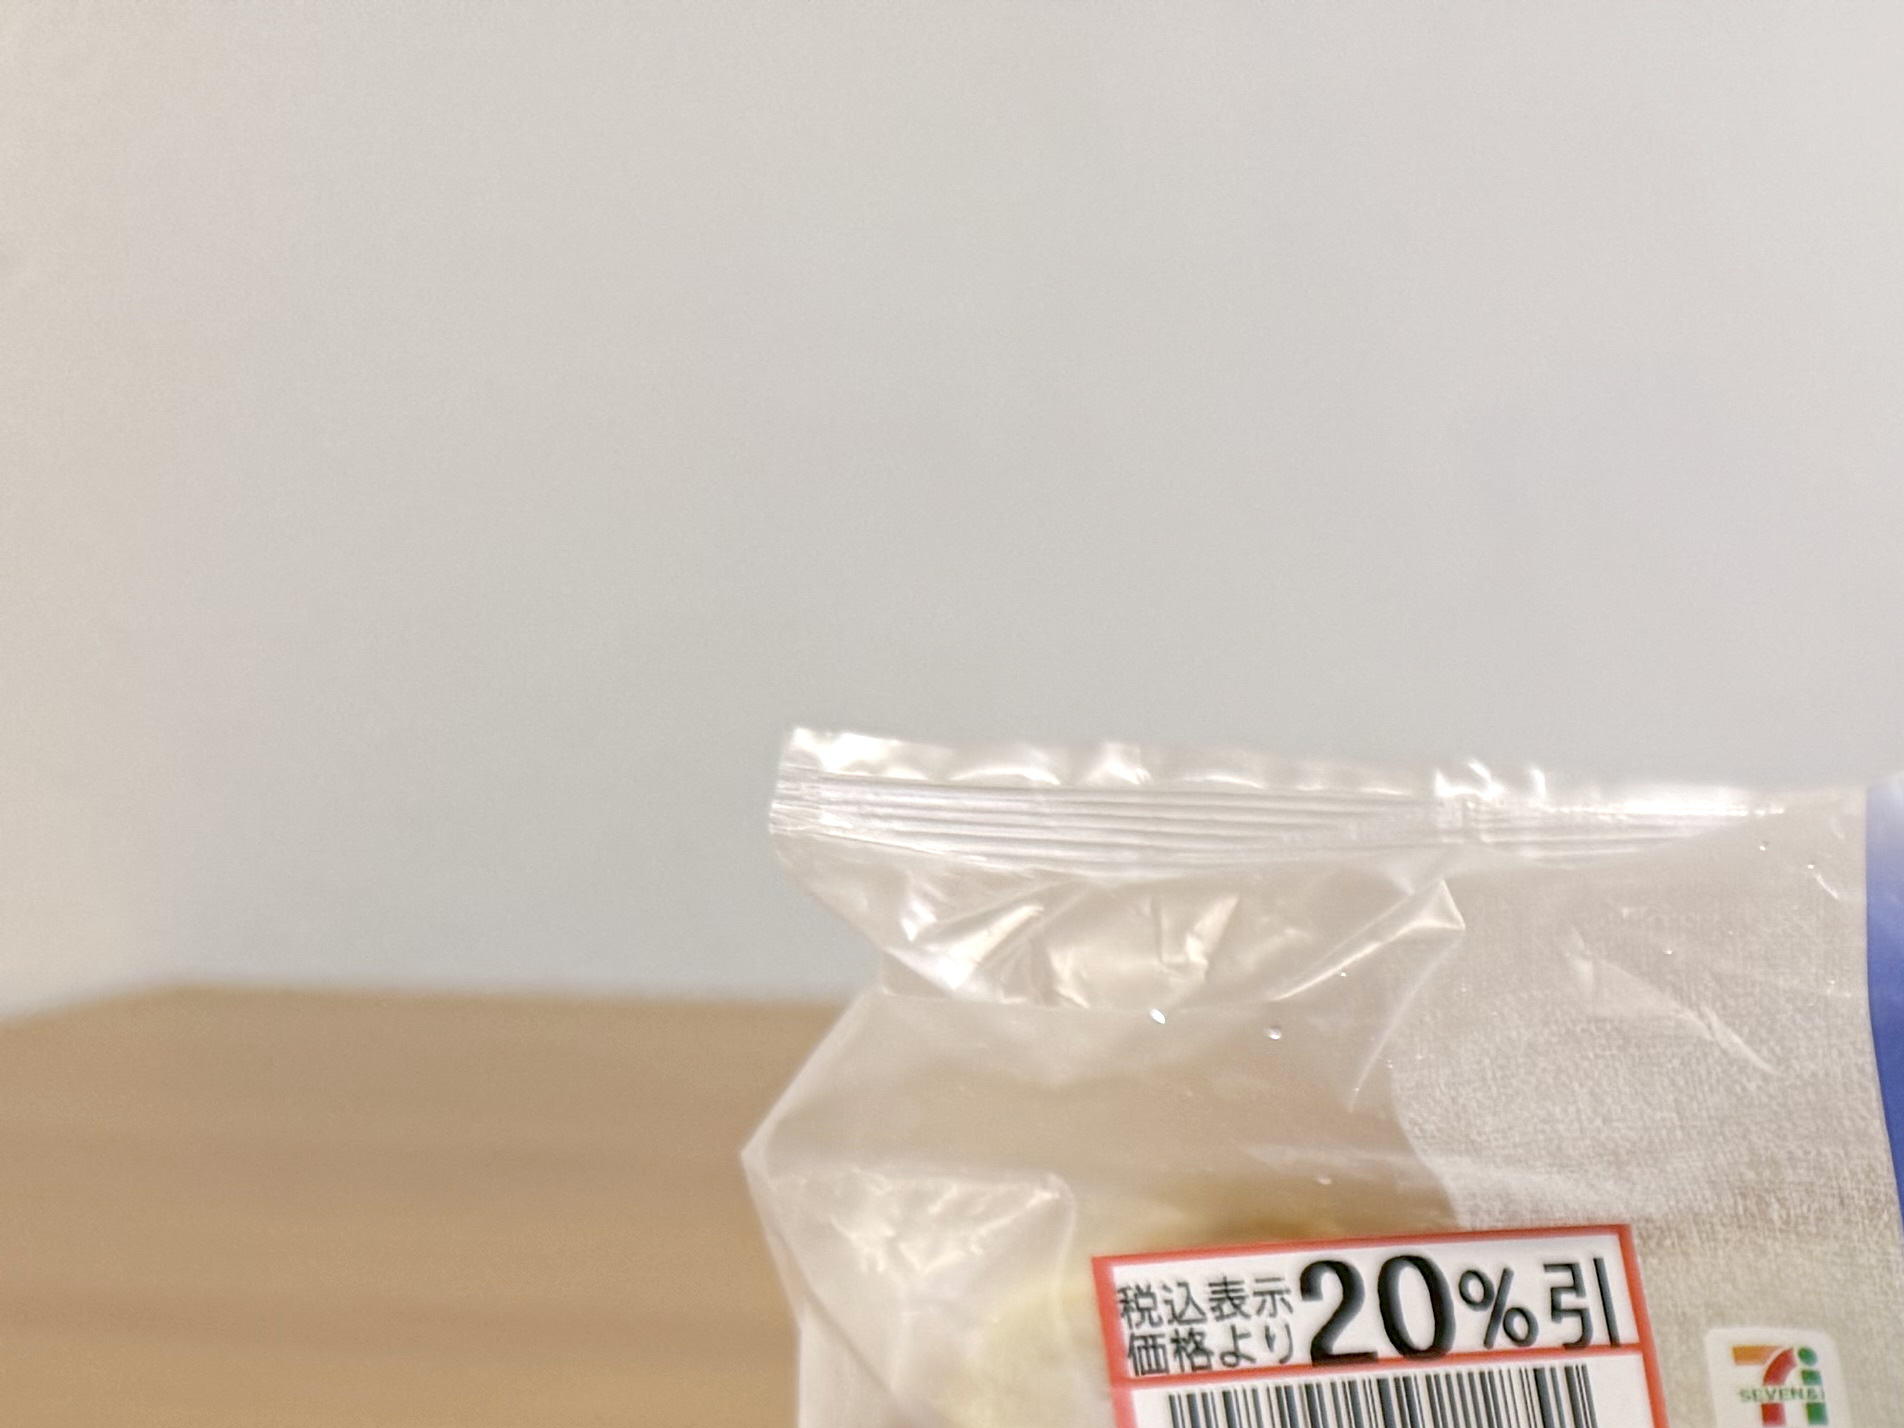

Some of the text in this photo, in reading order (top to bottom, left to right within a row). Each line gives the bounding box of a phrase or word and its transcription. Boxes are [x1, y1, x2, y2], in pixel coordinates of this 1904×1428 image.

[1118, 1276, 1293, 1331] 税込表示
[1300, 1254, 1622, 1367] 20%引
[1127, 1321, 1293, 1377] 価格より
